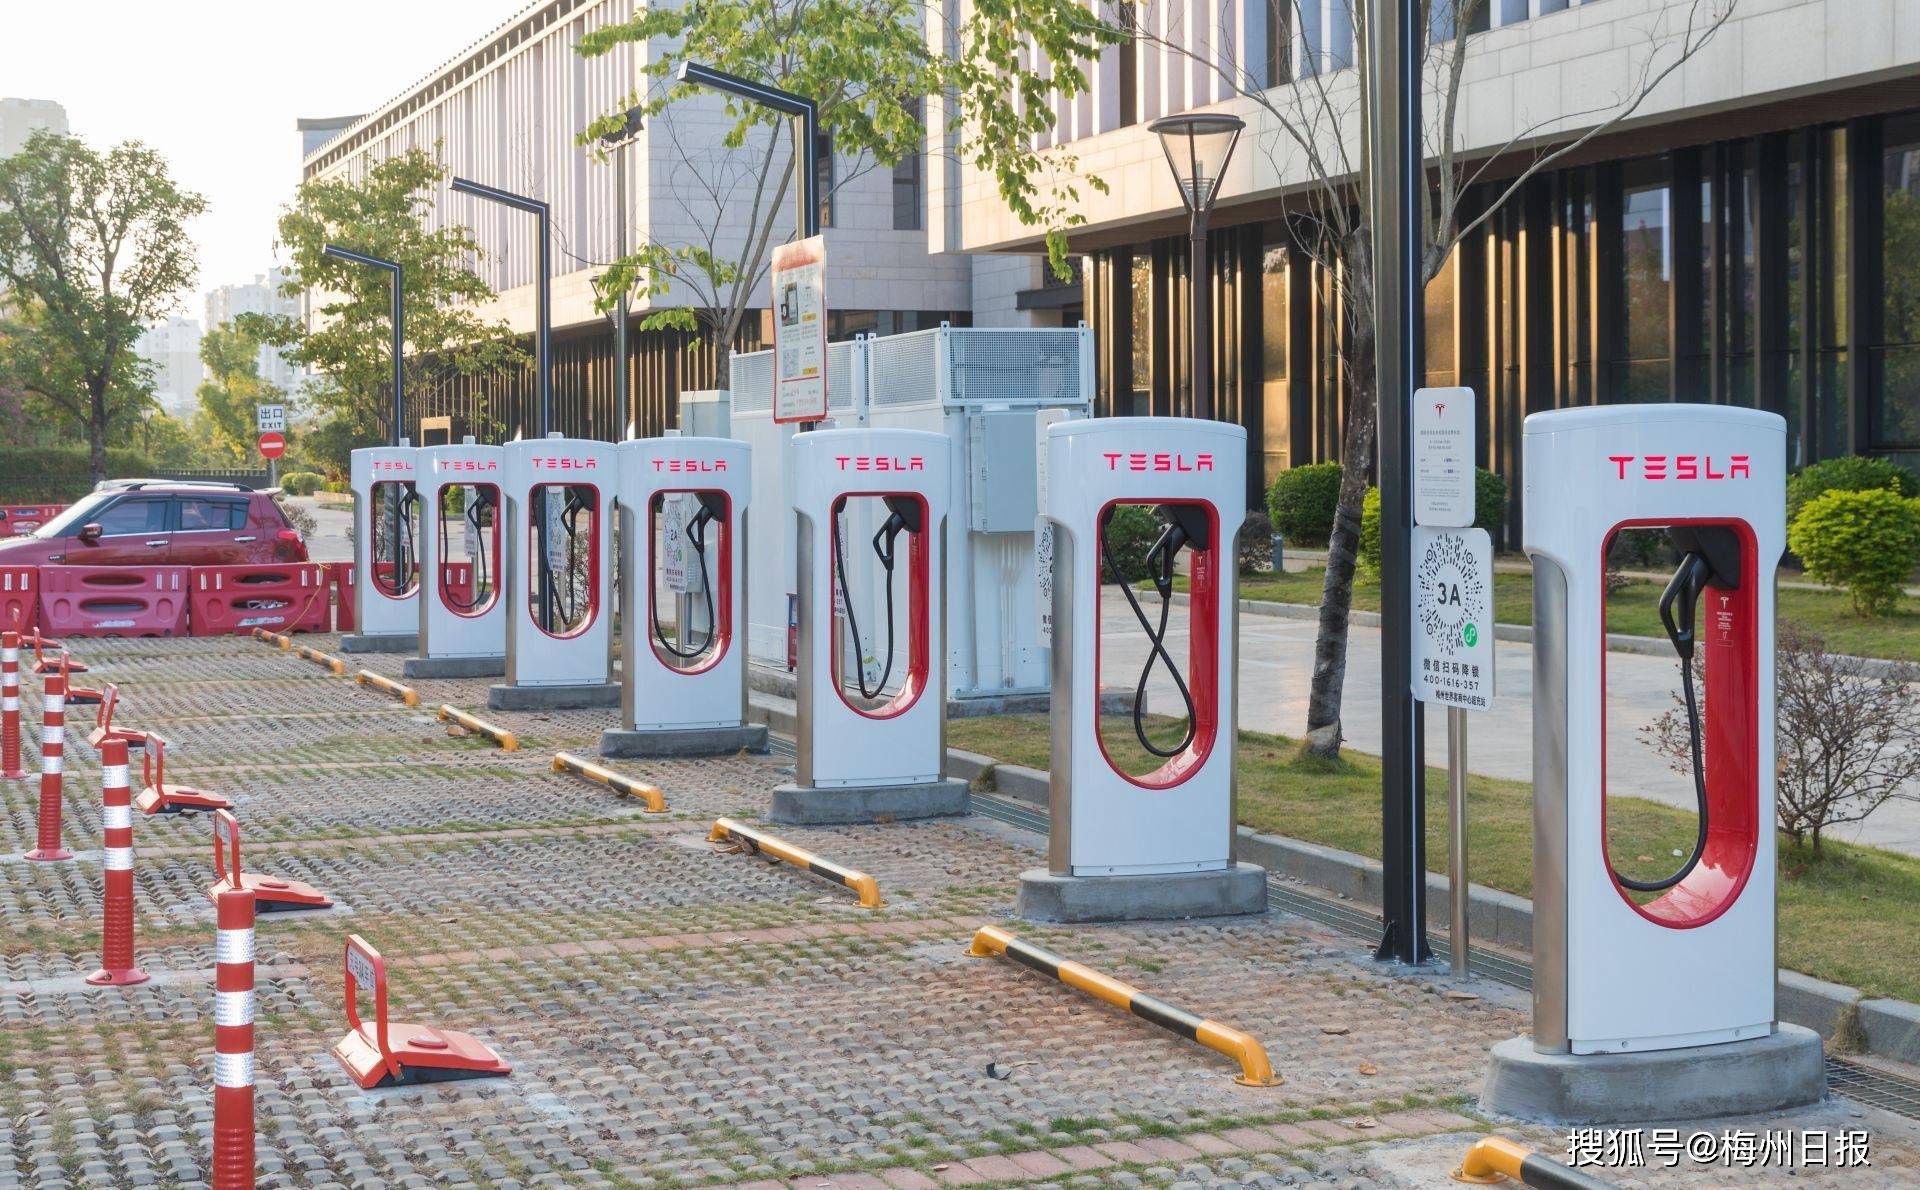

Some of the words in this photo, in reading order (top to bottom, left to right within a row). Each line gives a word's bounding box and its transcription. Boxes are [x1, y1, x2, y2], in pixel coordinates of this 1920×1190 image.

[260, 407, 283, 419] 出口
[374, 462, 413, 470] TESL
[441, 461, 497, 471] TESLA
[532, 458, 597, 470] TESLA
[652, 459, 728, 473] TESLA
[836, 456, 925, 472] TESLA
[1103, 453, 1214, 473] TESLA
[1608, 455, 1751, 480] TESLA
[1437, 582, 1461, 606] 3A
[1423, 658, 1480, 678] 微信扫码降锁
